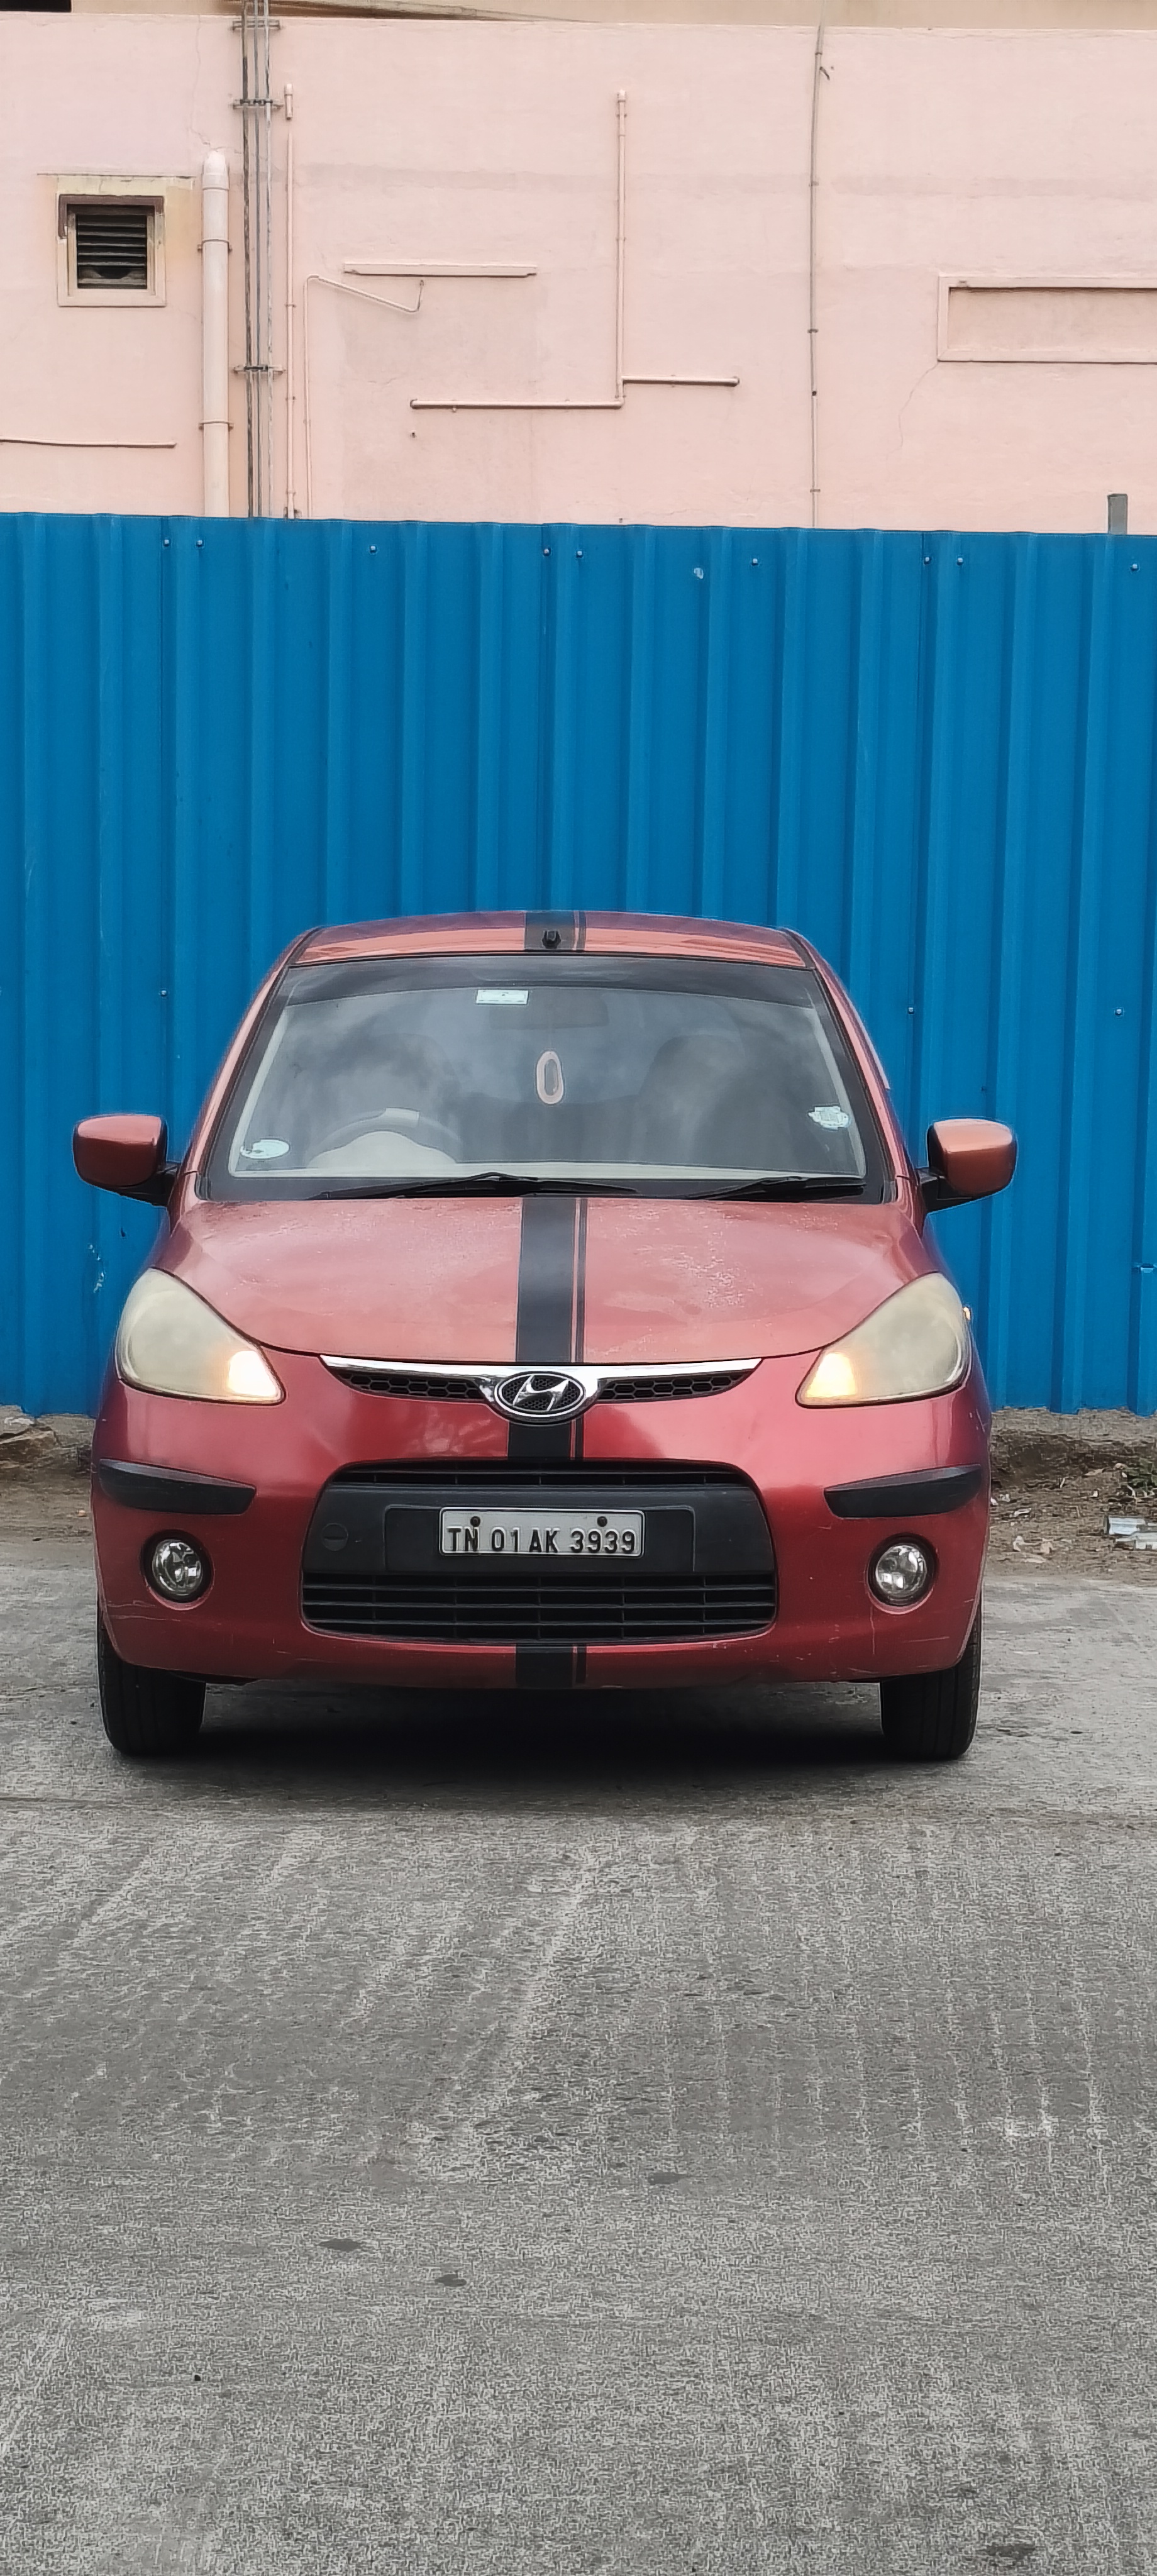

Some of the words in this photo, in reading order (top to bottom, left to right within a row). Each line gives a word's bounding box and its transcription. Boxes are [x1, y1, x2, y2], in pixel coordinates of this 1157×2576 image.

[447, 1526, 479, 1552] TN
[492, 1528, 519, 1552] 01
[528, 1528, 560, 1553] AK
[570, 1530, 636, 1554] 3939
